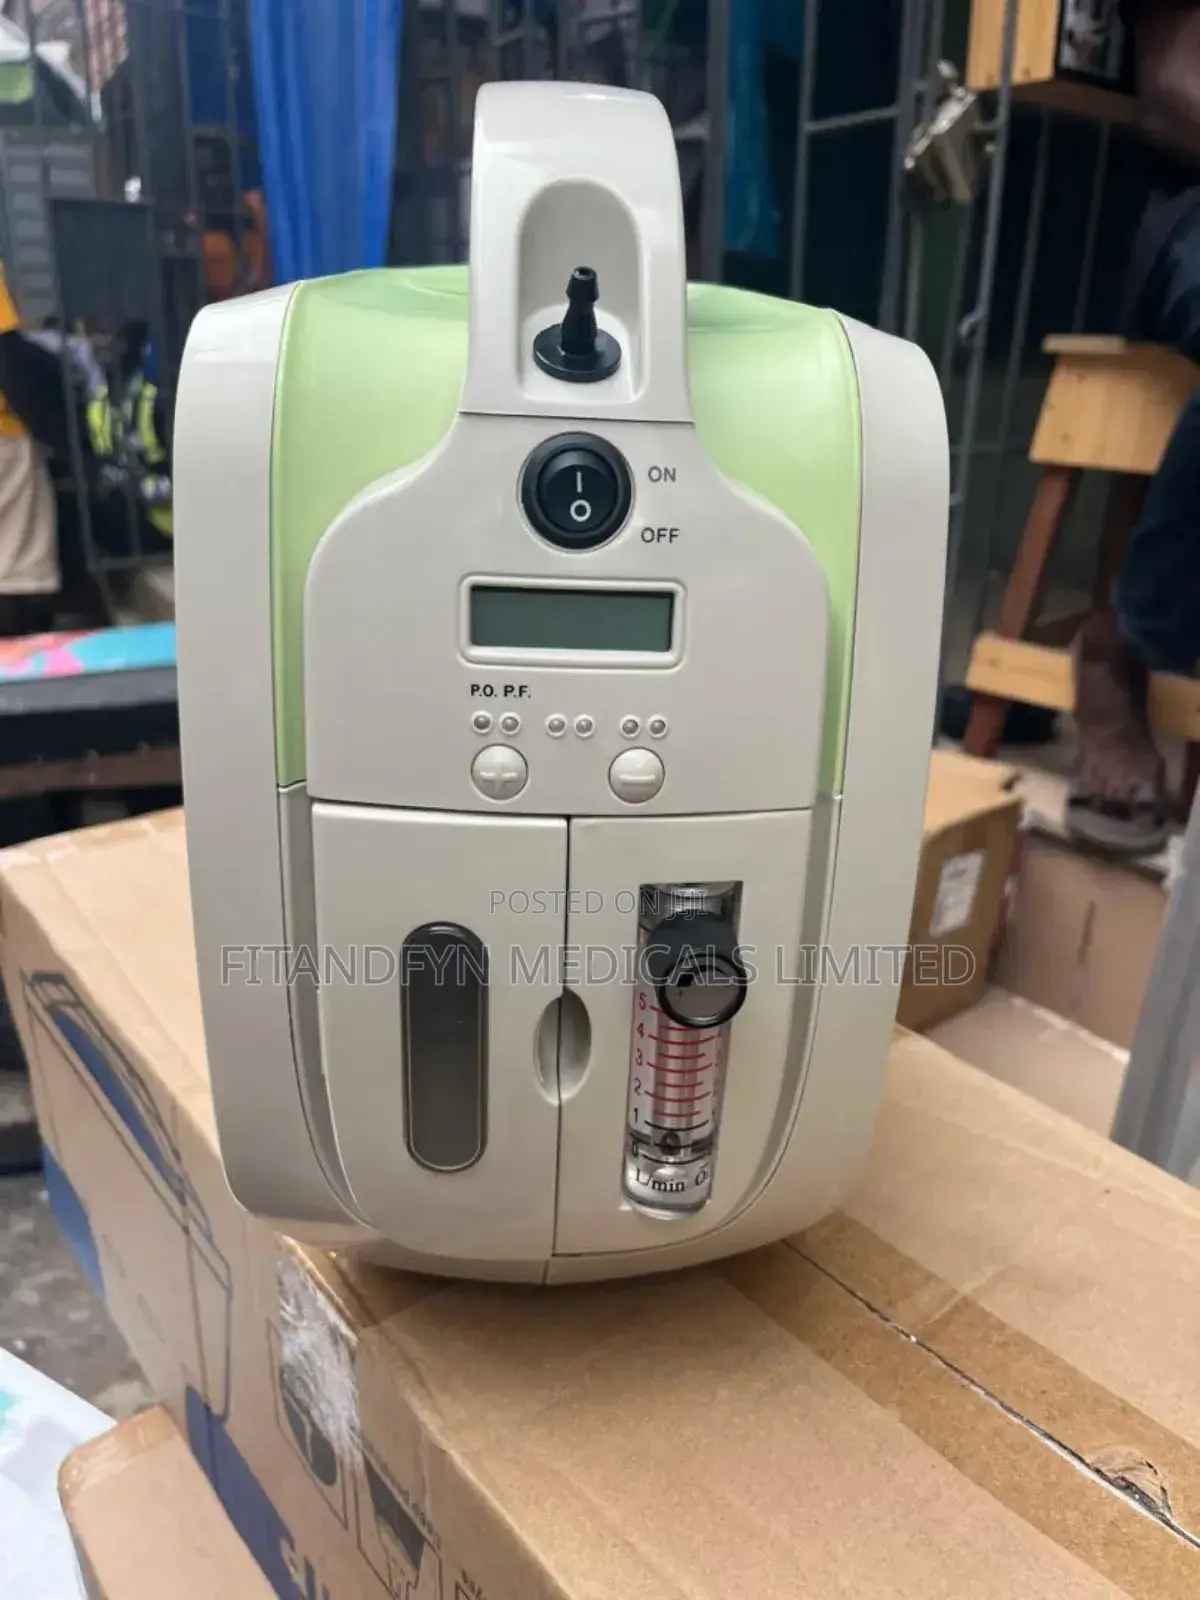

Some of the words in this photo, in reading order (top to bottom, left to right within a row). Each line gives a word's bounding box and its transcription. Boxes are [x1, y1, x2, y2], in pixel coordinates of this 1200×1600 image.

[648, 466, 676, 483] ON
[640, 527, 680, 543] OFF
[470, 684, 497, 698] P.O.
[503, 684, 531, 698] P.F.
[638, 992, 647, 1010] 5
[637, 1022, 644, 1038] 4
[634, 1077, 642, 1096] 2
[634, 1107, 638, 1124] 1
